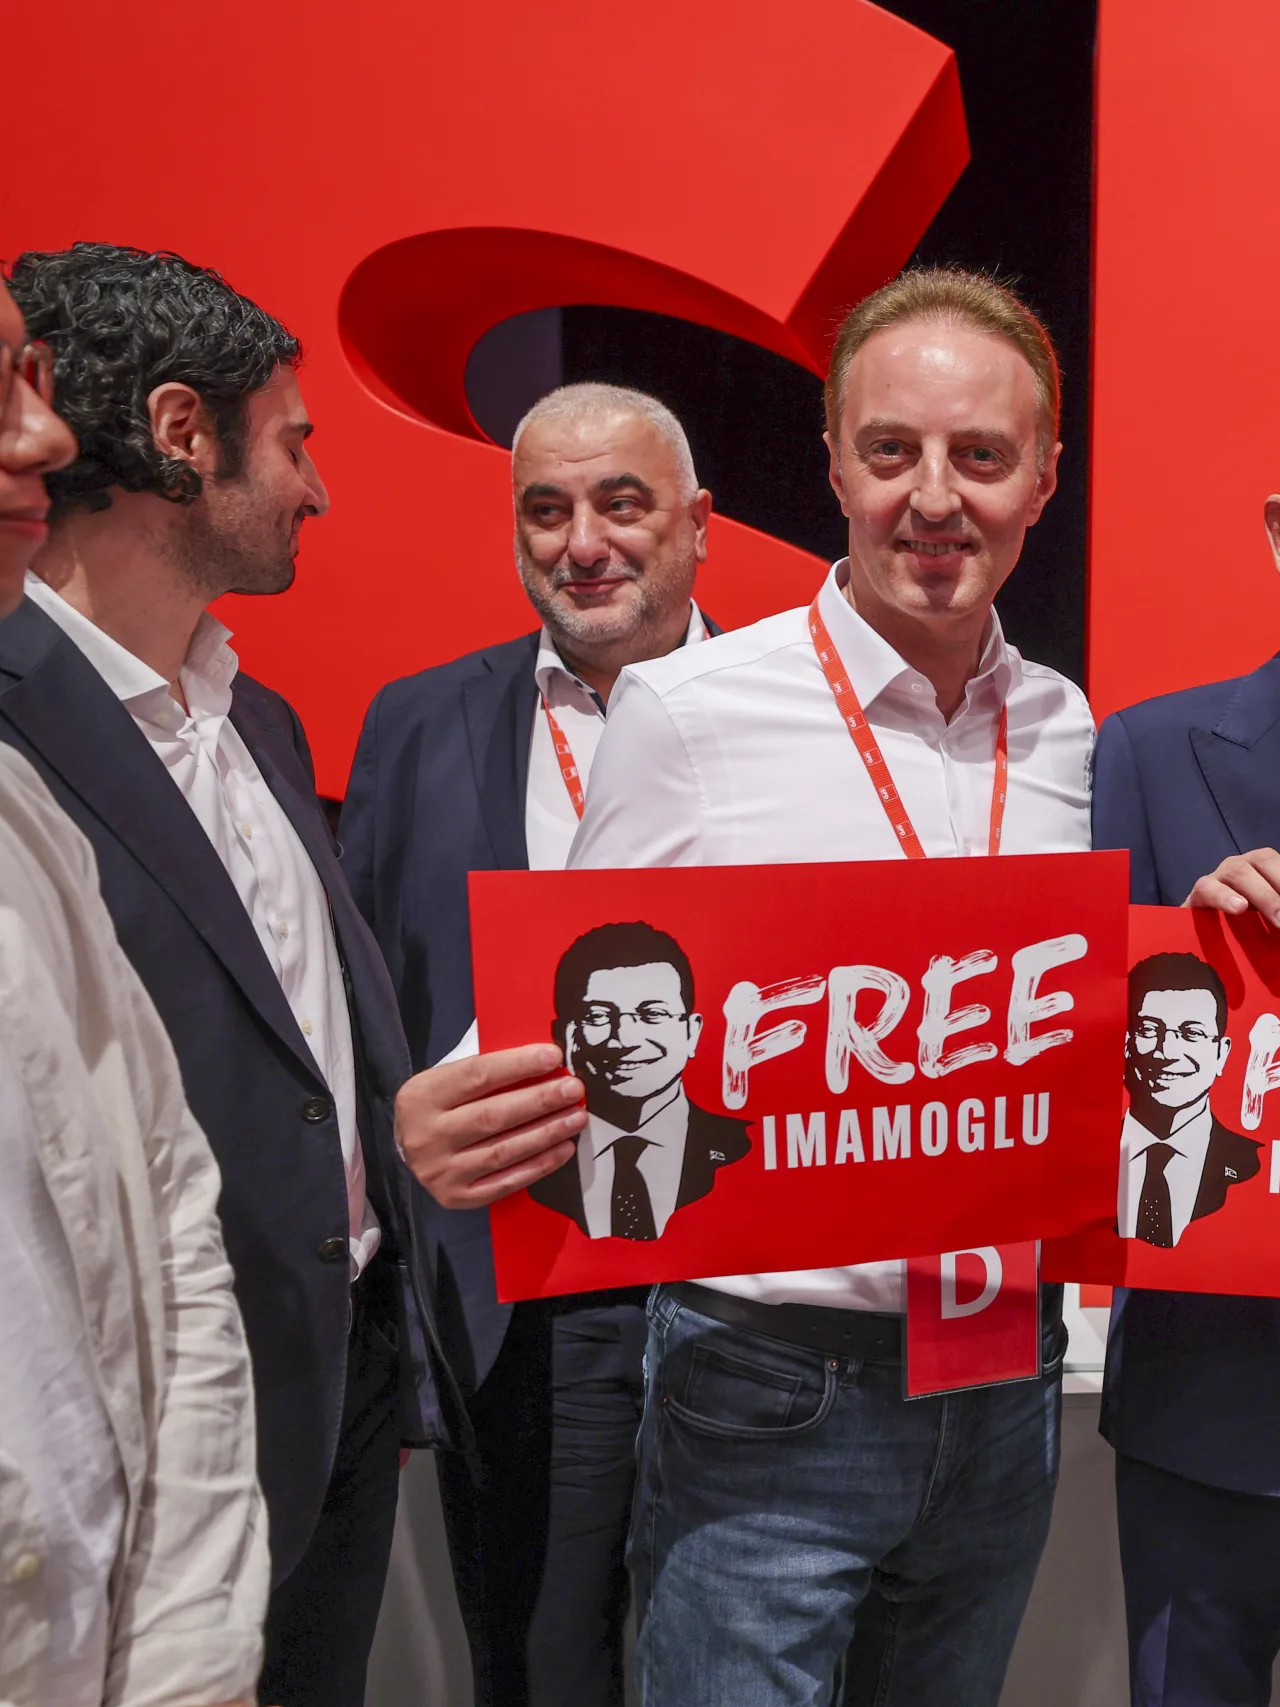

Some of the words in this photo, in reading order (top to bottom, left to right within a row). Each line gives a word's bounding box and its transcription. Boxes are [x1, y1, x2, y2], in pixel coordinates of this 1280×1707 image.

[864, 751, 874, 764] SPD
[880, 788, 889, 800] SPD
[723, 934, 1088, 1110] FREE
[762, 1093, 1051, 1171] IMAMOGLU
[940, 1245, 1003, 1320] D
